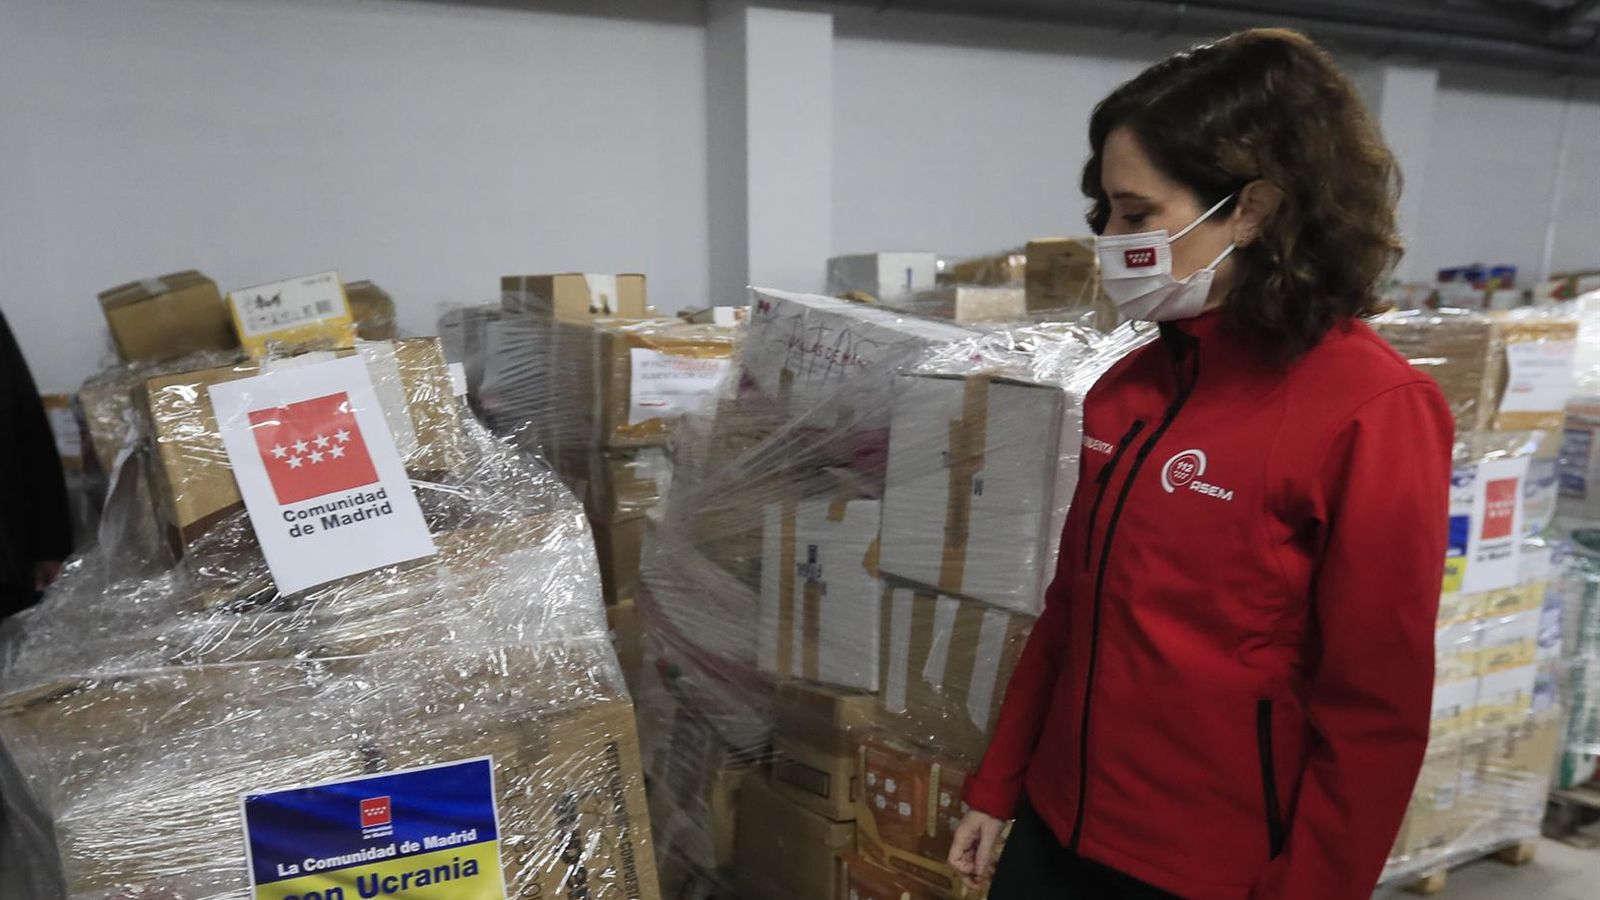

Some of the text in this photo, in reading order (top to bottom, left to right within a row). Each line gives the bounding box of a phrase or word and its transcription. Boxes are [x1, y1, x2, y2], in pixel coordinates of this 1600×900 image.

[1176, 461, 1194, 473] 112
[282, 487, 388, 523] Comunidad
[1189, 480, 1234, 501] ASEM
[289, 501, 393, 539] de Madrid
[277, 828, 477, 877] La Comunidad de Madrid
[356, 857, 480, 900] Ucrania
